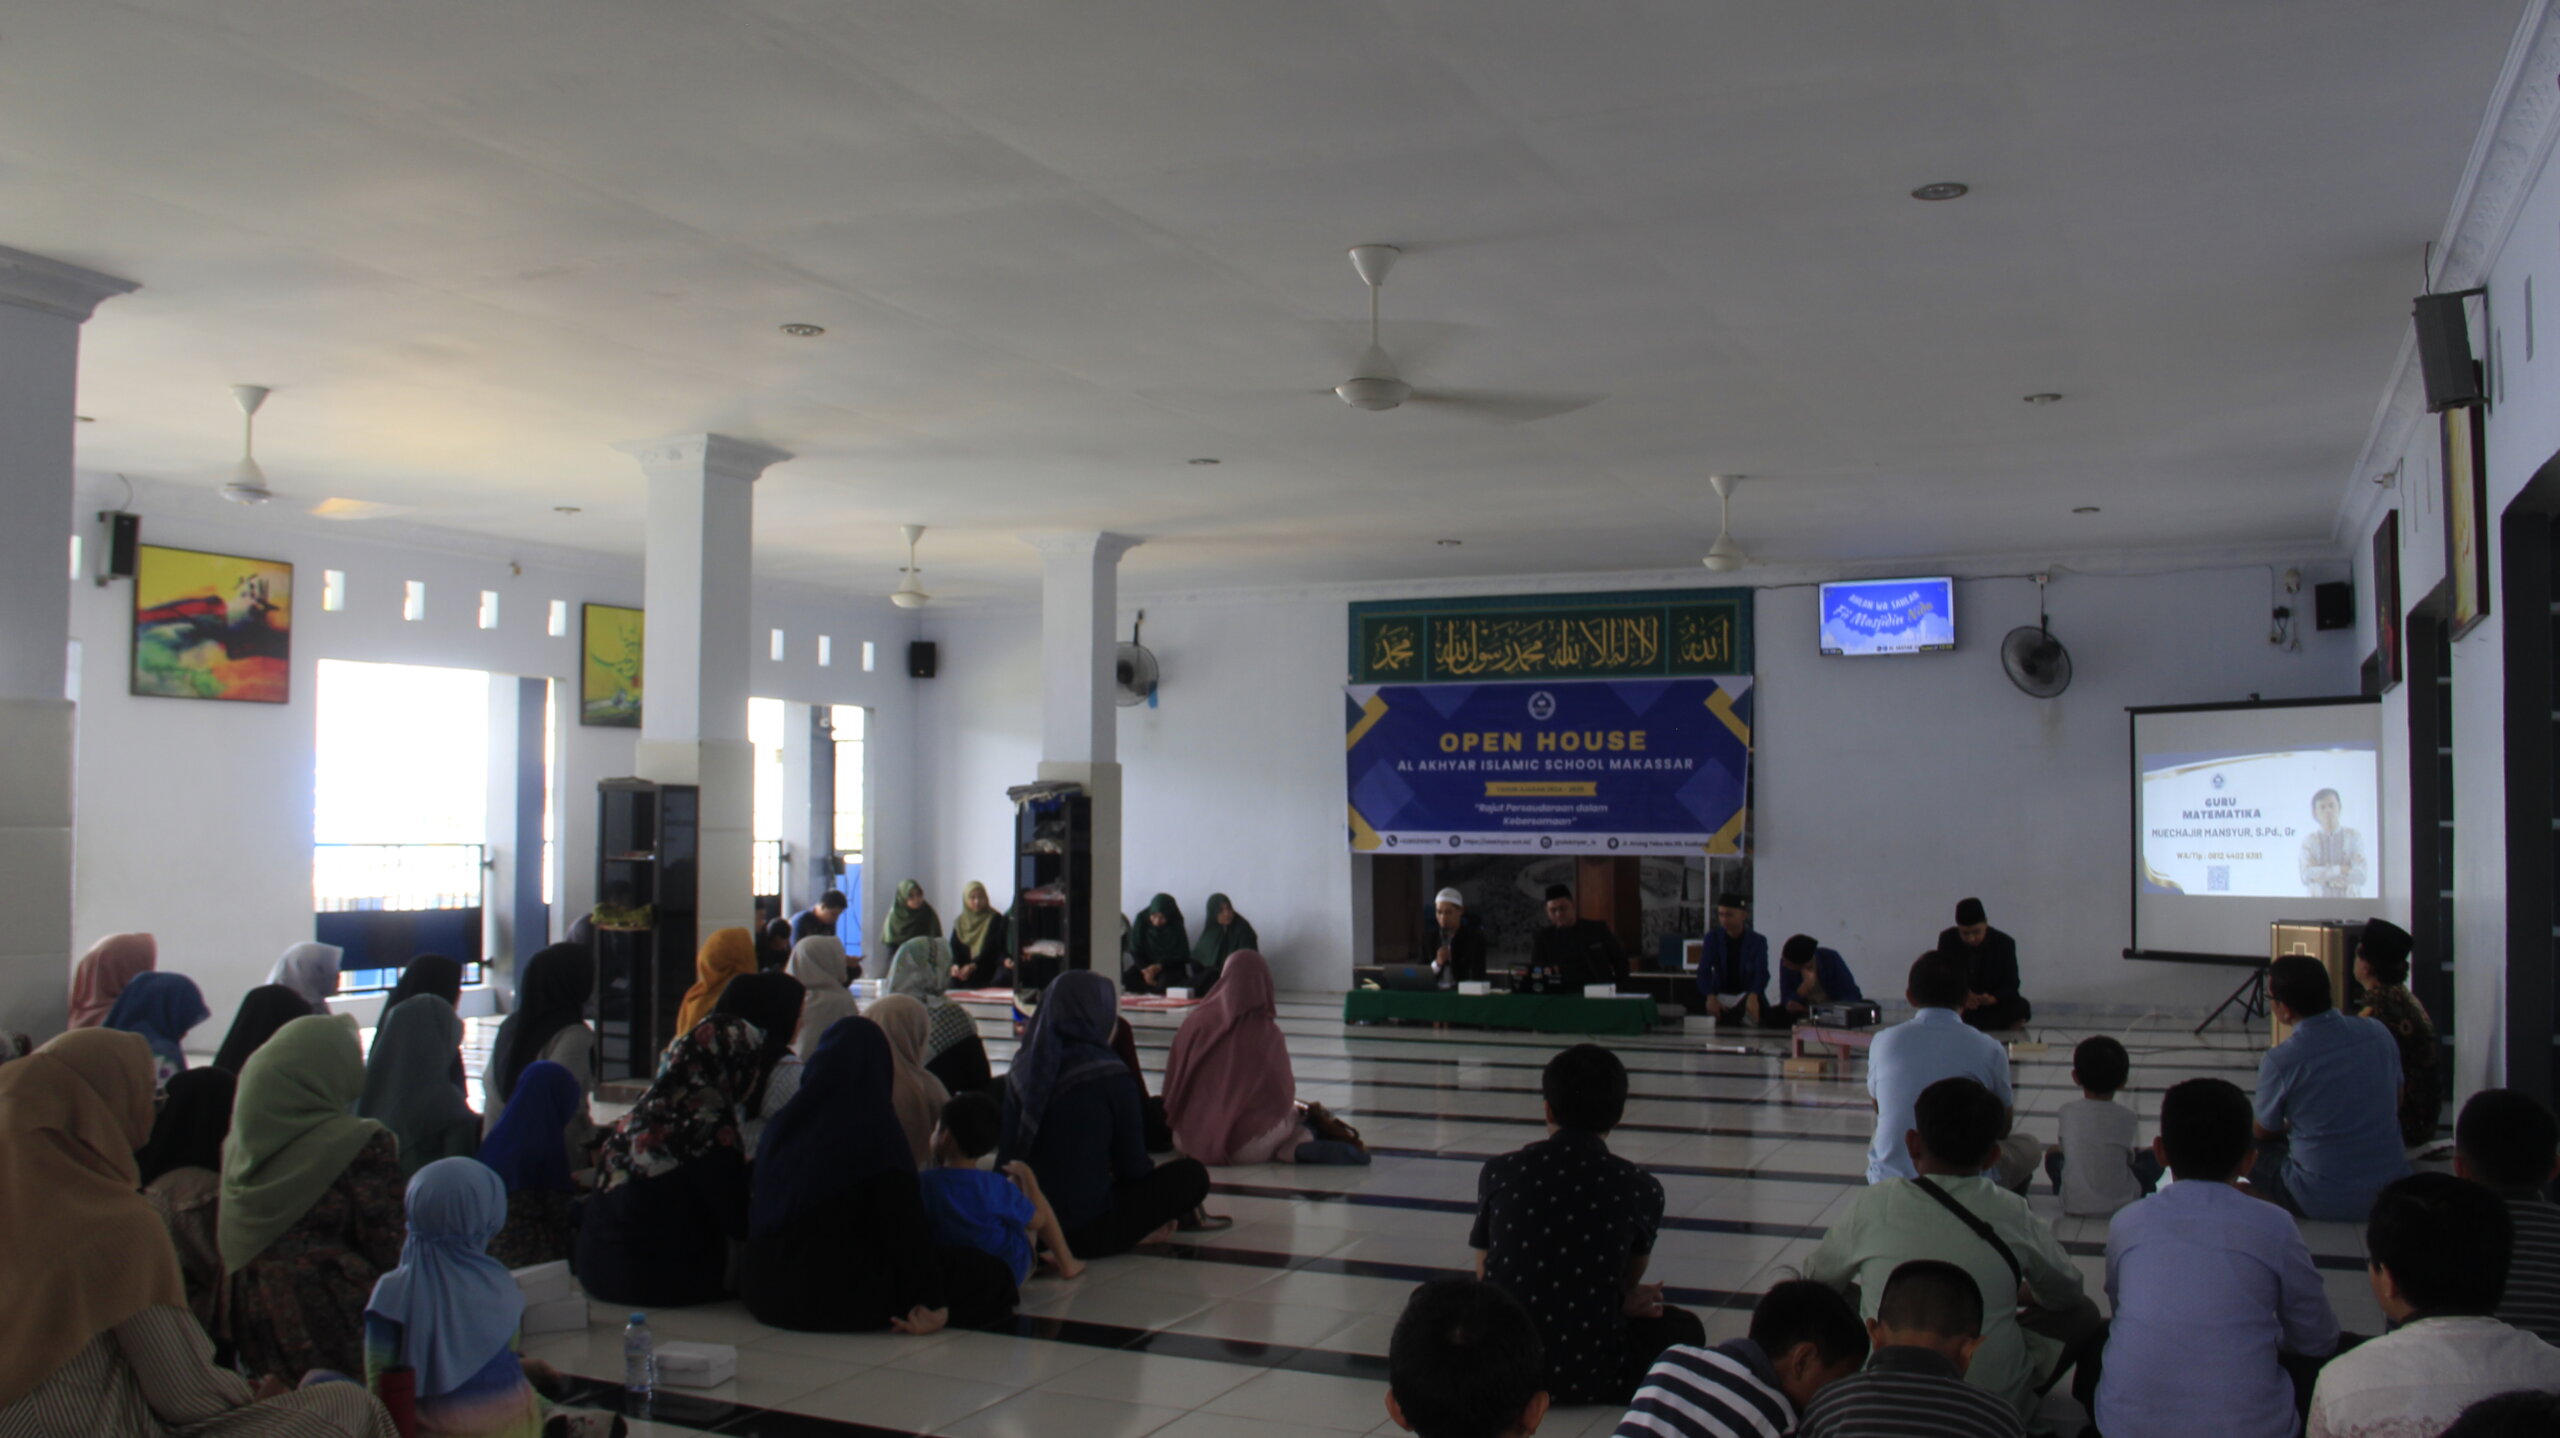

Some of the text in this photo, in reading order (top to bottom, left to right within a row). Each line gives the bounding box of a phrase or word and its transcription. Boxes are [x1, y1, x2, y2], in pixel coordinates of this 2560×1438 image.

[1875, 601, 1888, 611] WA
[1439, 730, 1647, 752] OPEN HOUSE
[1397, 758, 1694, 771] AL AKHYAR ISLAMIC SCHOOL MAKASSAR
[1505, 802, 1574, 813] Persaudaraan
[1576, 802, 1608, 813] dalam
[2205, 797, 2236, 807] GURU
[2182, 808, 2261, 820] MATEMATIKA
[2151, 828, 2202, 838] MUECHAJIR
[2204, 827, 2253, 838] MANSYUR,
[2285, 826, 2296, 837] Gr
